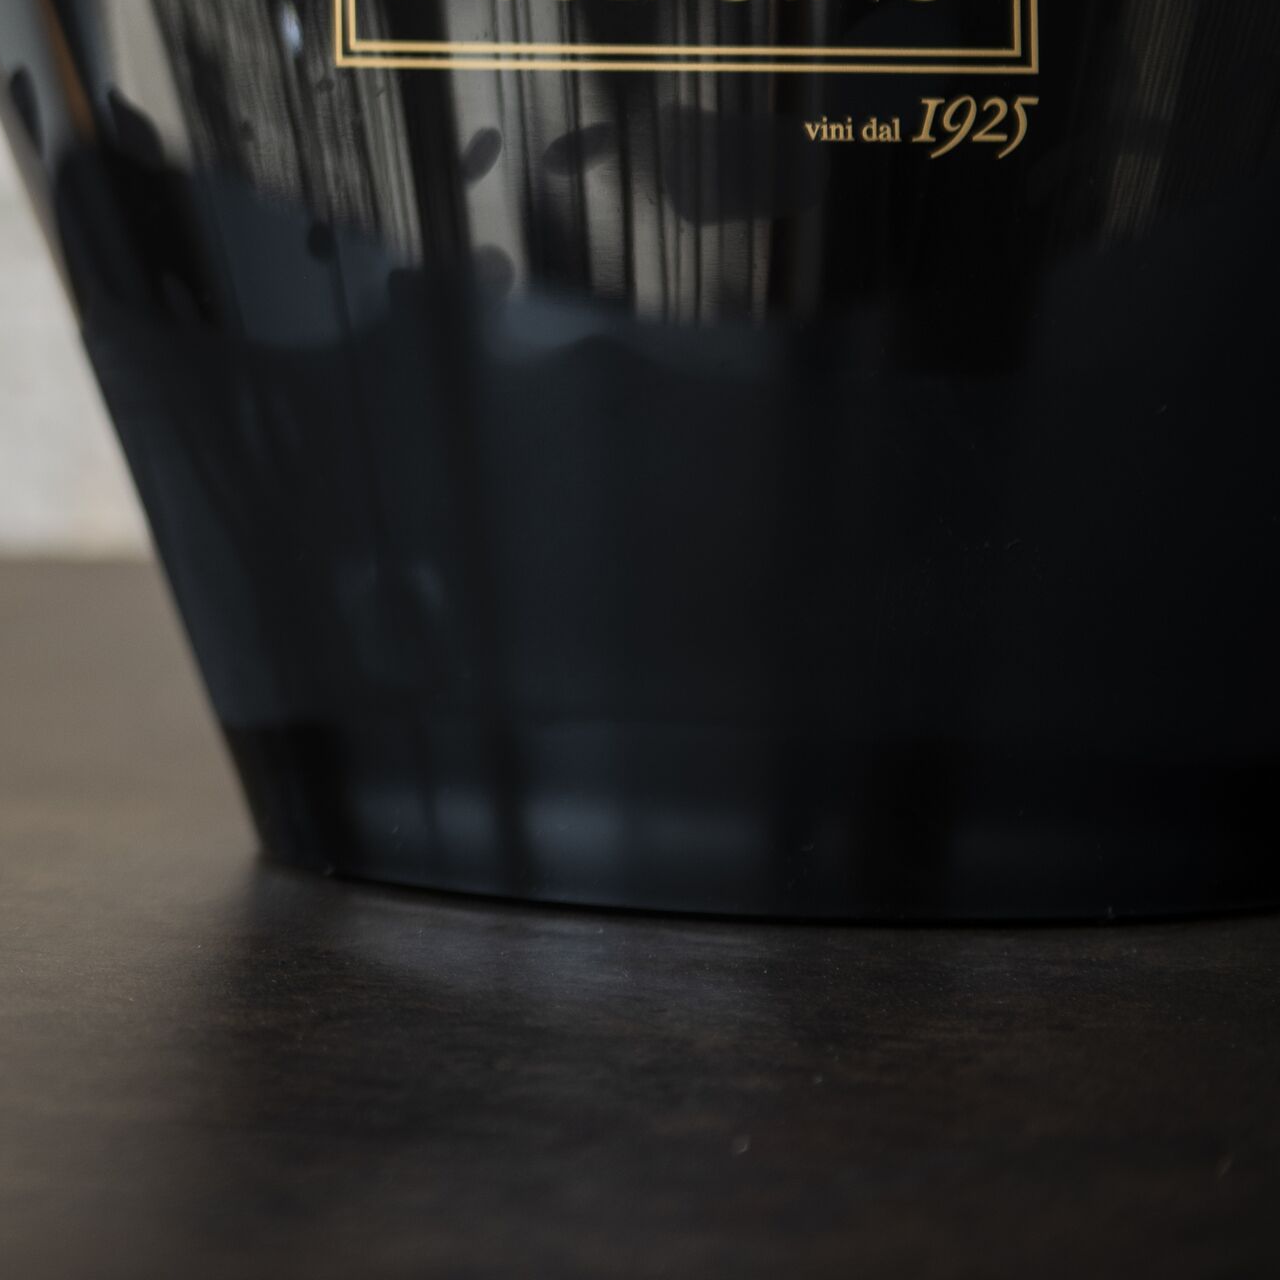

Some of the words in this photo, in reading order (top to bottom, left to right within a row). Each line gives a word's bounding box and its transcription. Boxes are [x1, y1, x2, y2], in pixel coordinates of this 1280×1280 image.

[804, 116, 854, 142] vini
[861, 116, 901, 142] dal
[911, 94, 1040, 159] 1925
